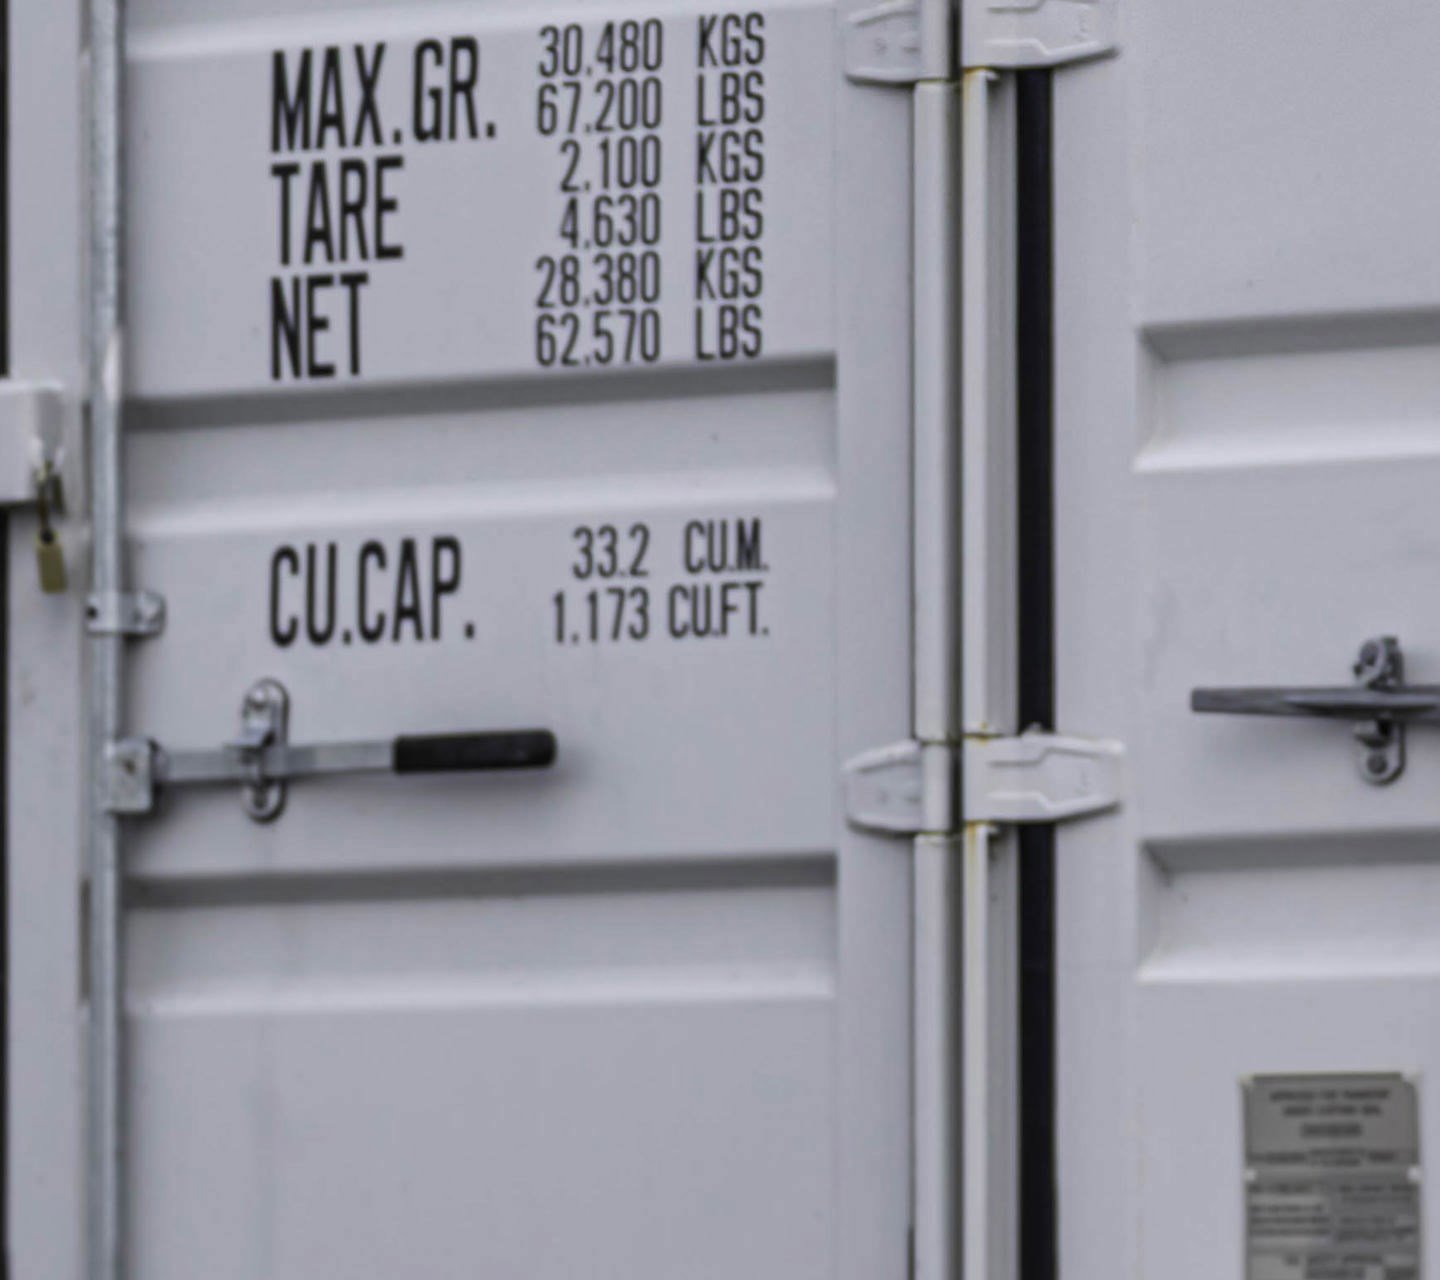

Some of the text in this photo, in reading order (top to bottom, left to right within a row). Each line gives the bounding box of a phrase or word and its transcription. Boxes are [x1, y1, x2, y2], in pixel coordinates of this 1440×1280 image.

[270, 36, 496, 153] MAX.GR.
[696, 12, 767, 68] KGS
[696, 70, 766, 127] LBS
[270, 154, 404, 266] TARE
[695, 129, 766, 185] KGS
[695, 187, 765, 244] LBS
[270, 271, 370, 381] NET
[694, 245, 765, 301] KGS
[694, 303, 764, 361] LBS
[269, 536, 475, 649] CU.CAP.
[572, 523, 650, 579] 33.2
